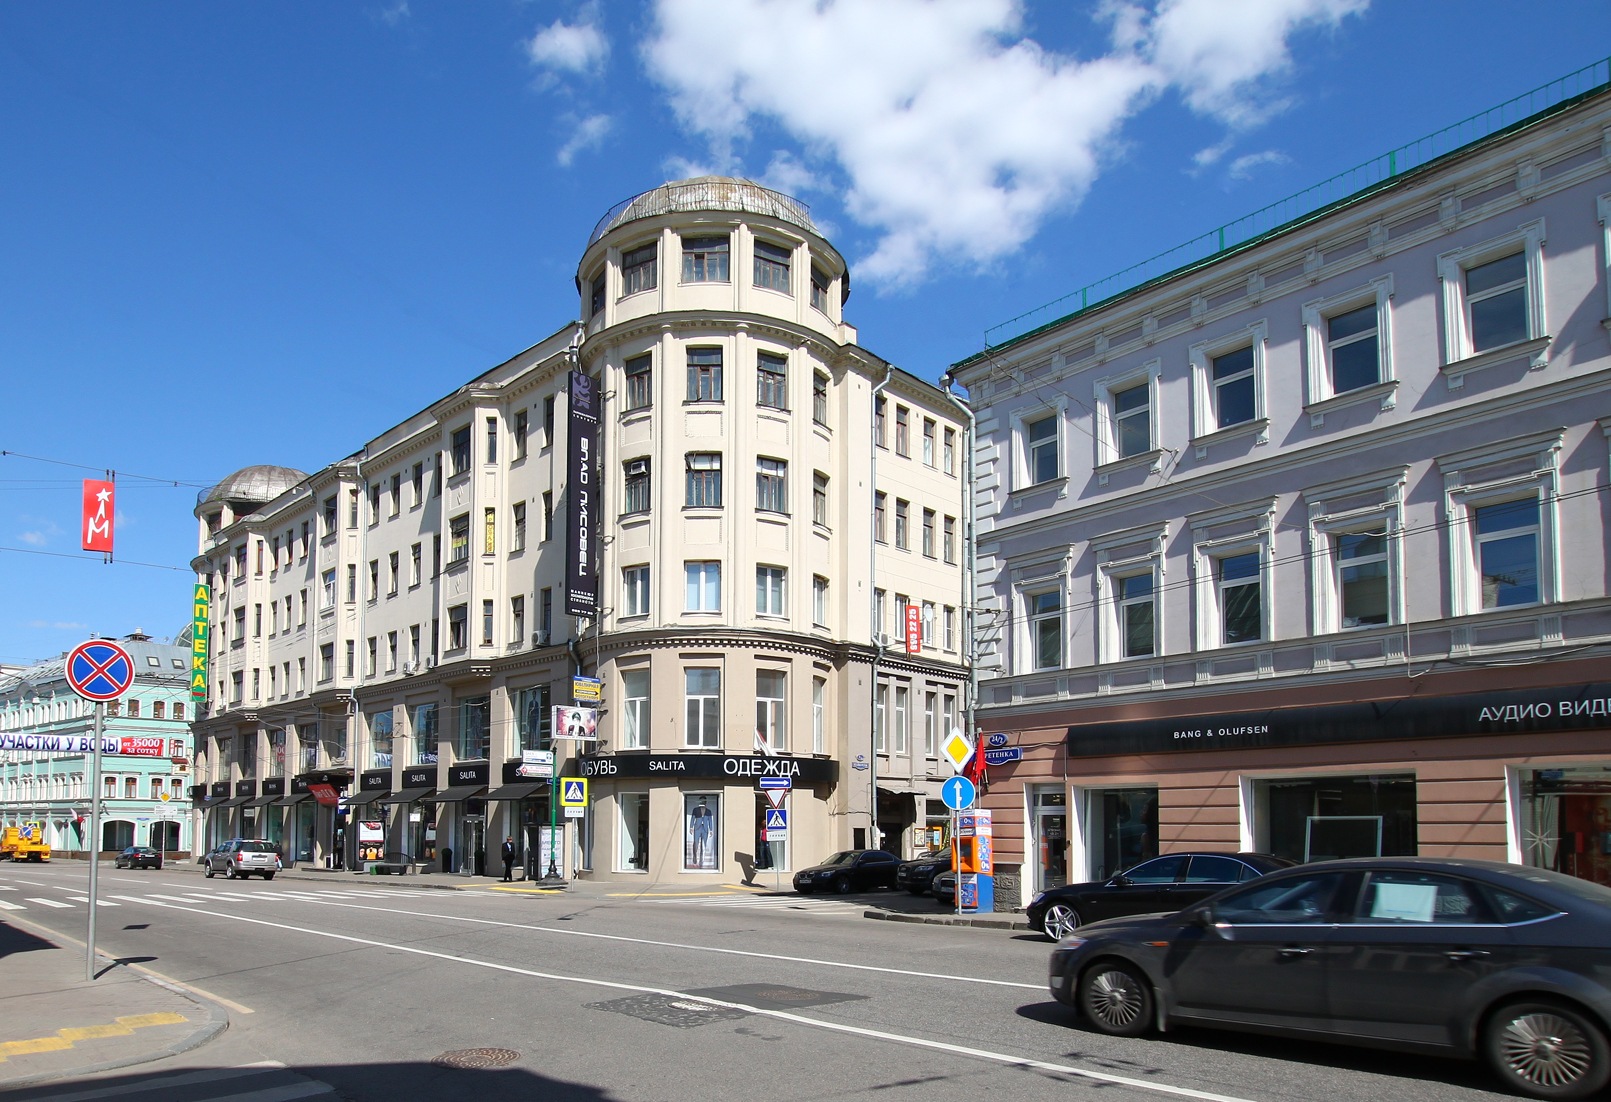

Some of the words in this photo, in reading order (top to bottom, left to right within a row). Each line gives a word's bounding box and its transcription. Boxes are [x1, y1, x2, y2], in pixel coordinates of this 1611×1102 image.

[580, 437, 589, 484] ВЛАД
[579, 490, 588, 577] ЛИСОВЕЦ
[192, 586, 209, 688] АПТЕКА
[1479, 702, 1552, 723] АУДИО
[1173, 730, 1201, 739] BANG
[1206, 729, 1213, 737] &
[1218, 725, 1268, 736] OLUFSEN
[0, 734, 60, 750] УЧАСТКИ
[66, 737, 75, 751] У
[132, 738, 160, 748] 35000
[136, 747, 159, 756] сотку
[984, 751, 1014, 759] РЕТЕНКА
[580, 759, 618, 776] ОБУВЬ
[649, 760, 686, 771] SALITA
[723, 758, 800, 778] ОДЕЖДА
[368, 777, 382, 785] SALITA
[411, 774, 426, 782] SALITA
[459, 771, 477, 780] SALITA
